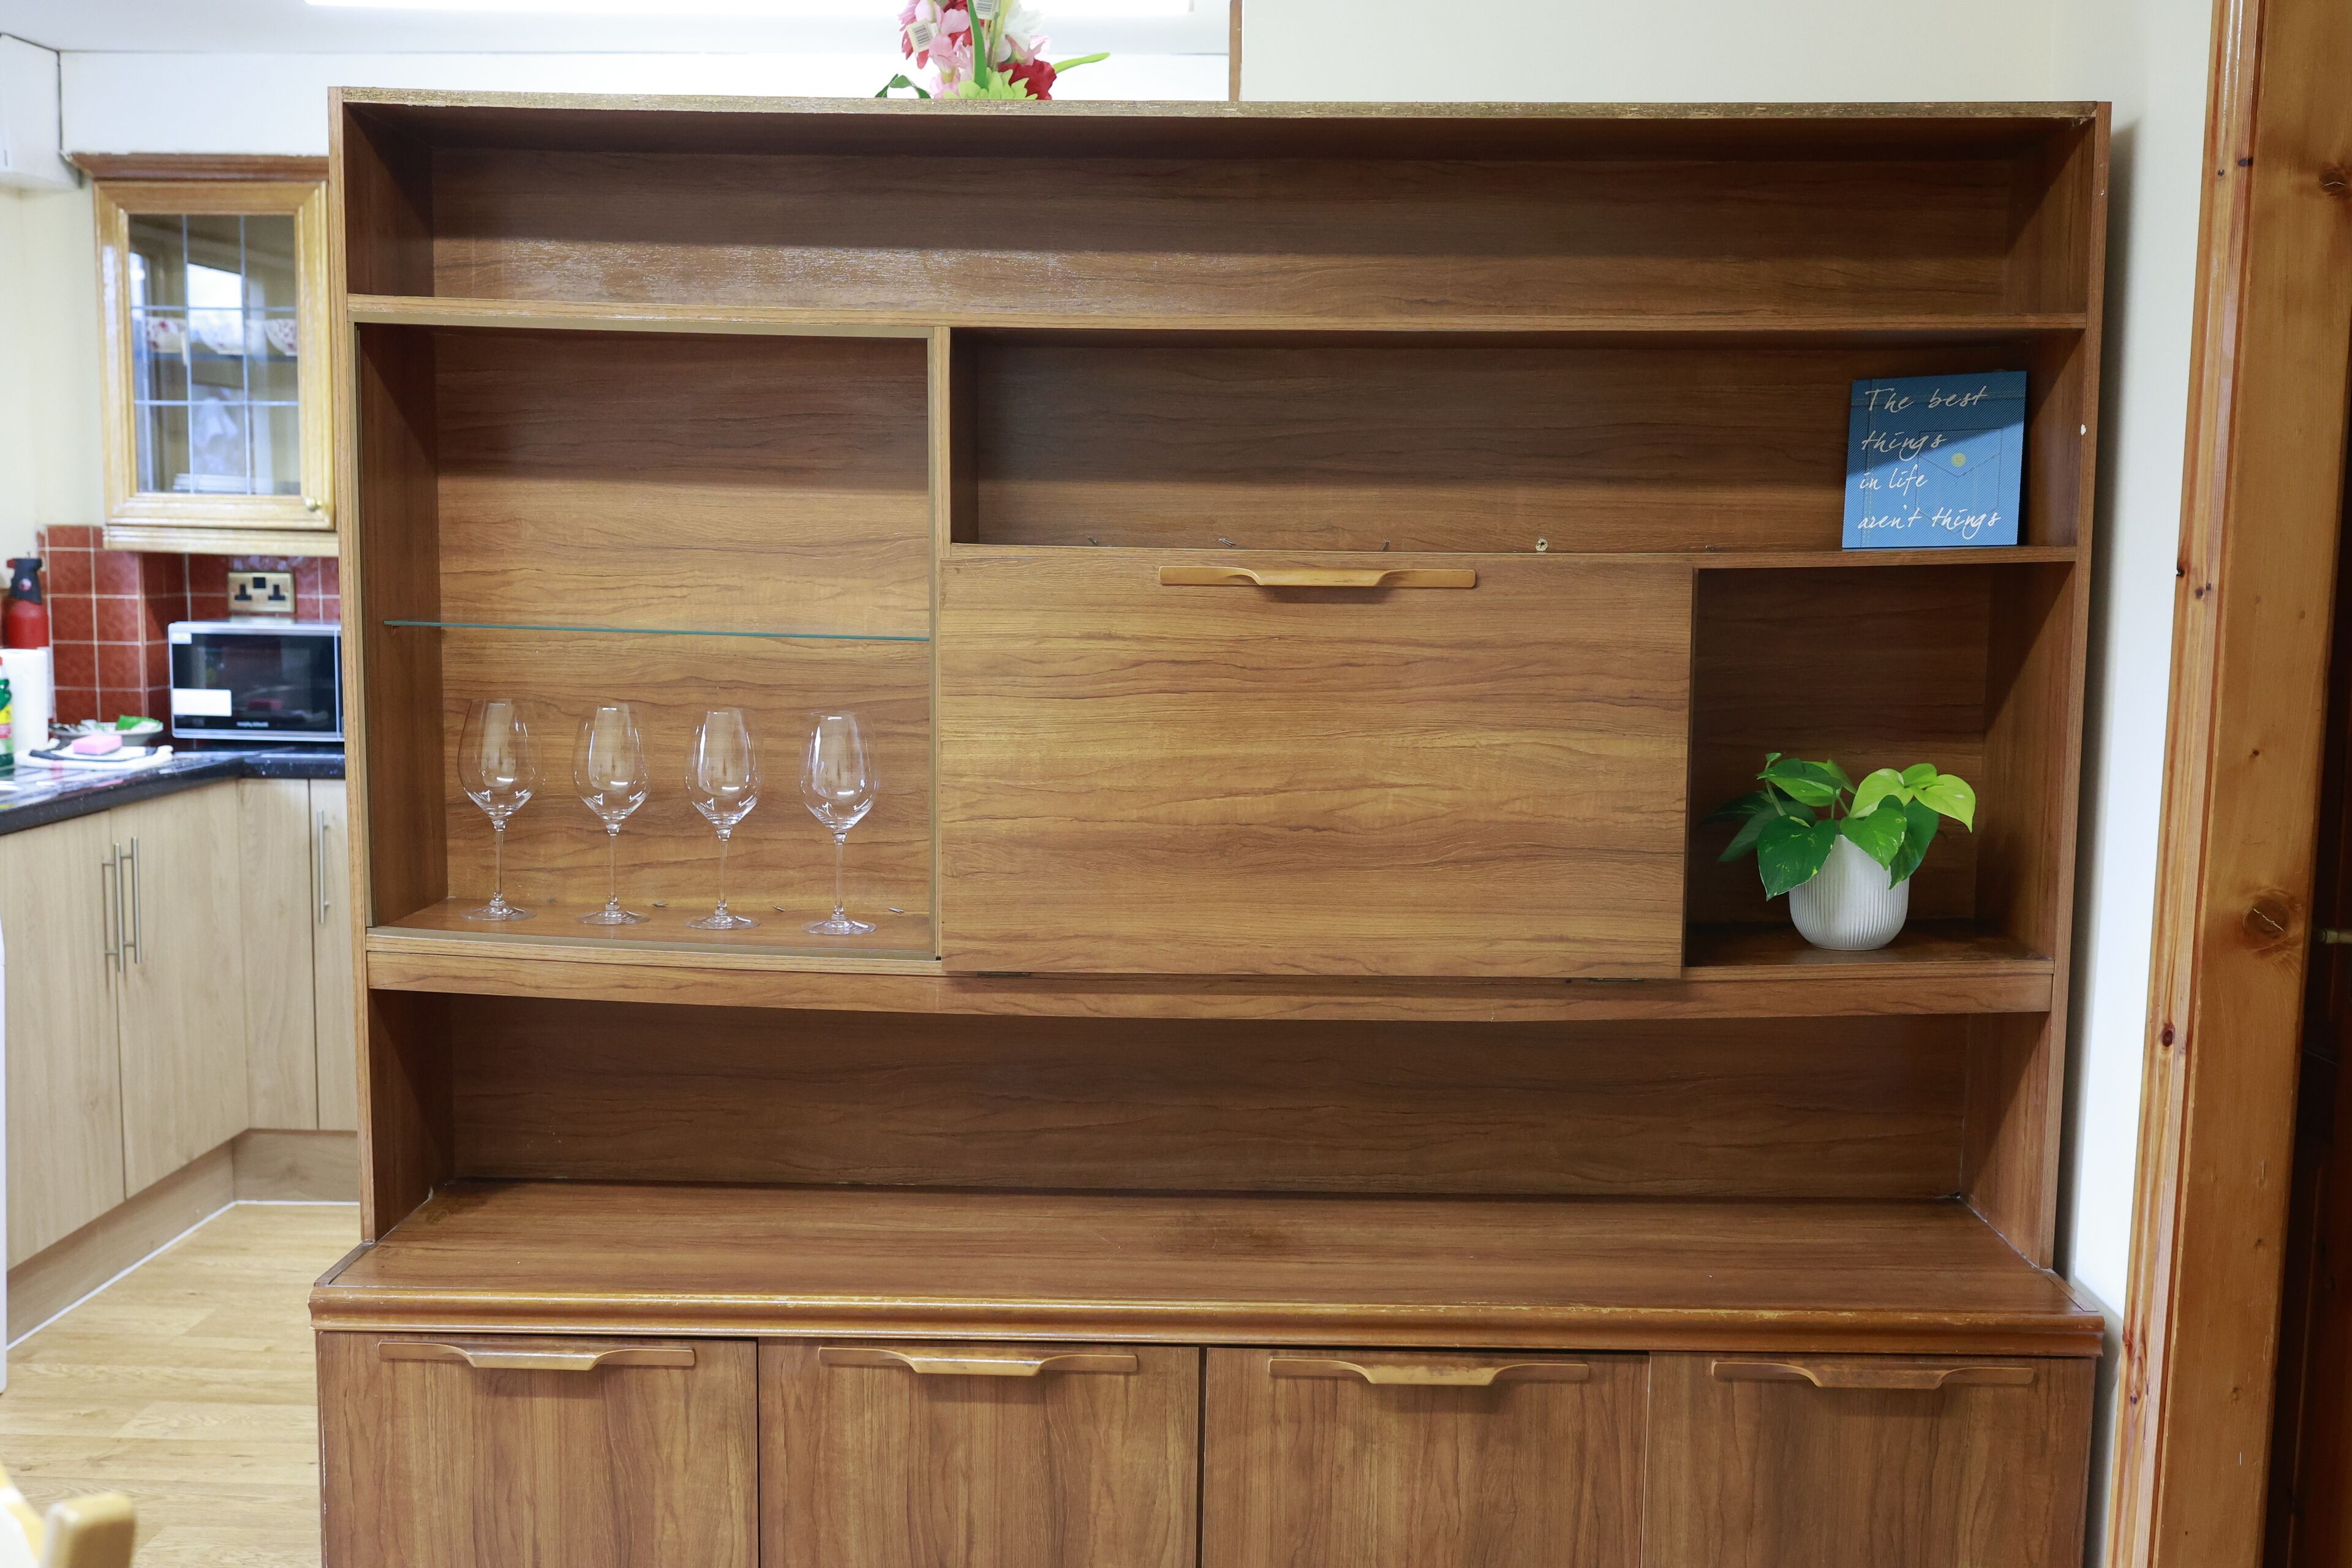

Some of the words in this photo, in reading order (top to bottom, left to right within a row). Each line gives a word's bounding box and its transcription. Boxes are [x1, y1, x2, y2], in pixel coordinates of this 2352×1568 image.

[1864, 388, 1913, 413] The
[1928, 385, 1988, 409] best
[1861, 430, 1947, 461] things
[1860, 472, 1882, 490] in
[1889, 464, 1929, 496] life
[1858, 504, 1922, 529] aren't
[1931, 507, 2002, 540] things
